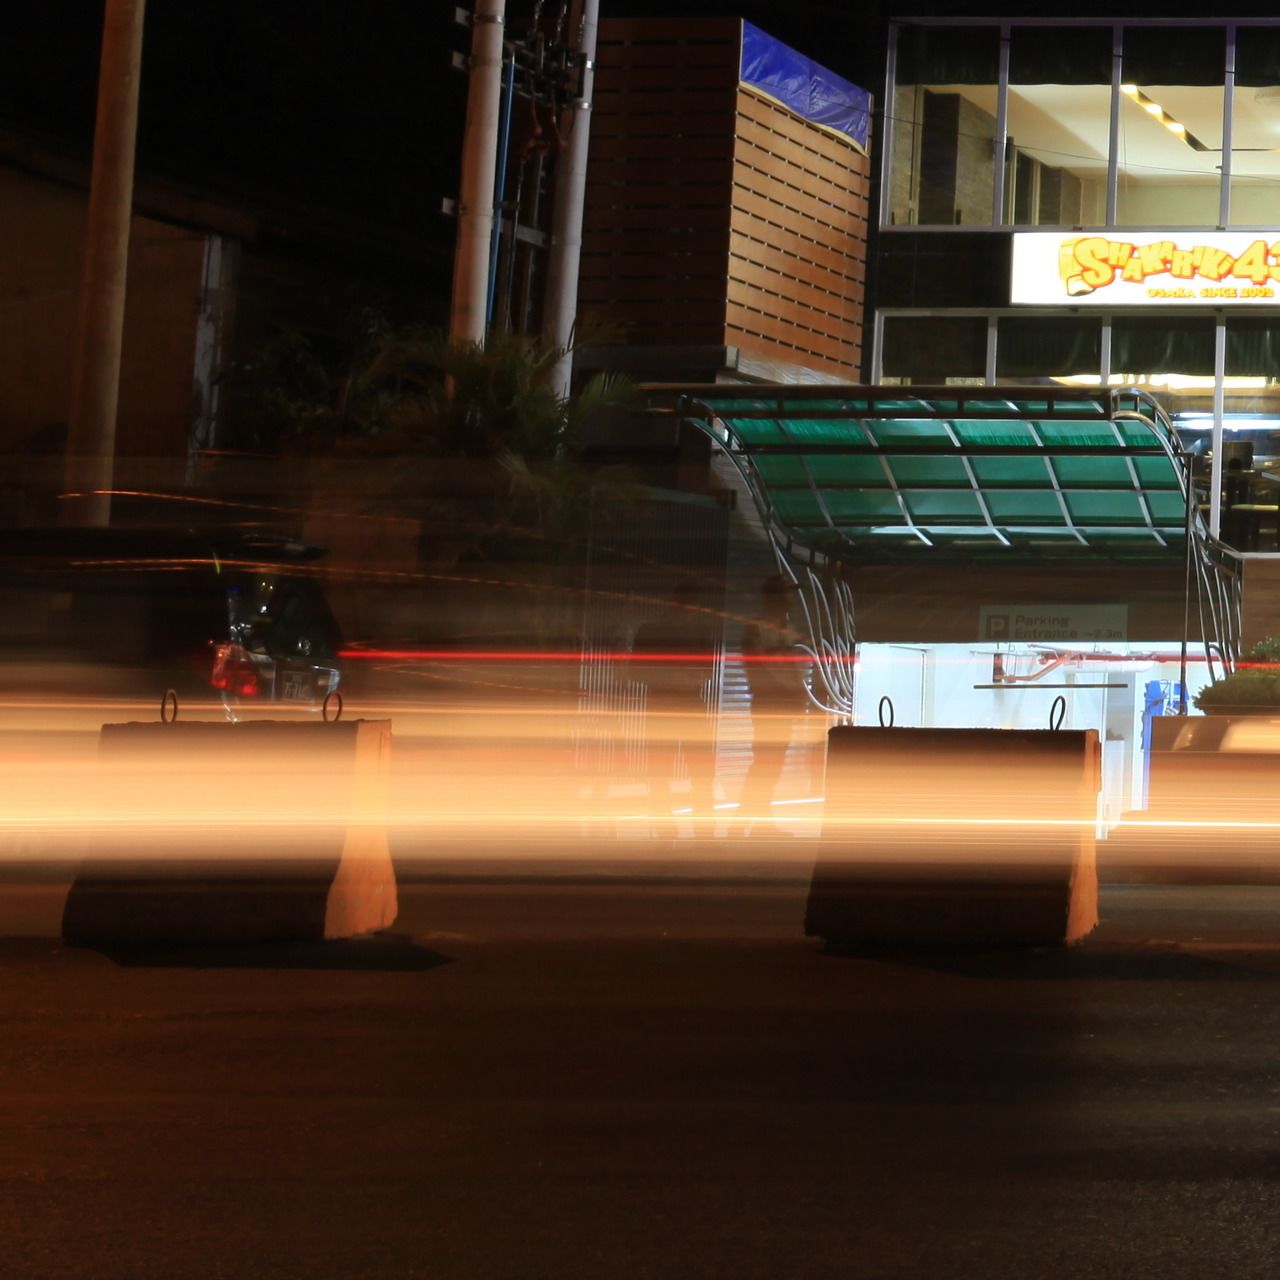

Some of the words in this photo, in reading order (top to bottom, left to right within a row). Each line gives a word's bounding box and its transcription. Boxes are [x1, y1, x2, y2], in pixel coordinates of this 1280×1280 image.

[1200, 287, 1237, 297] SINCE
[1240, 287, 1274, 297] 2002
[1015, 615, 1071, 628] Parking
[1014, 629, 1078, 639] Entrance
